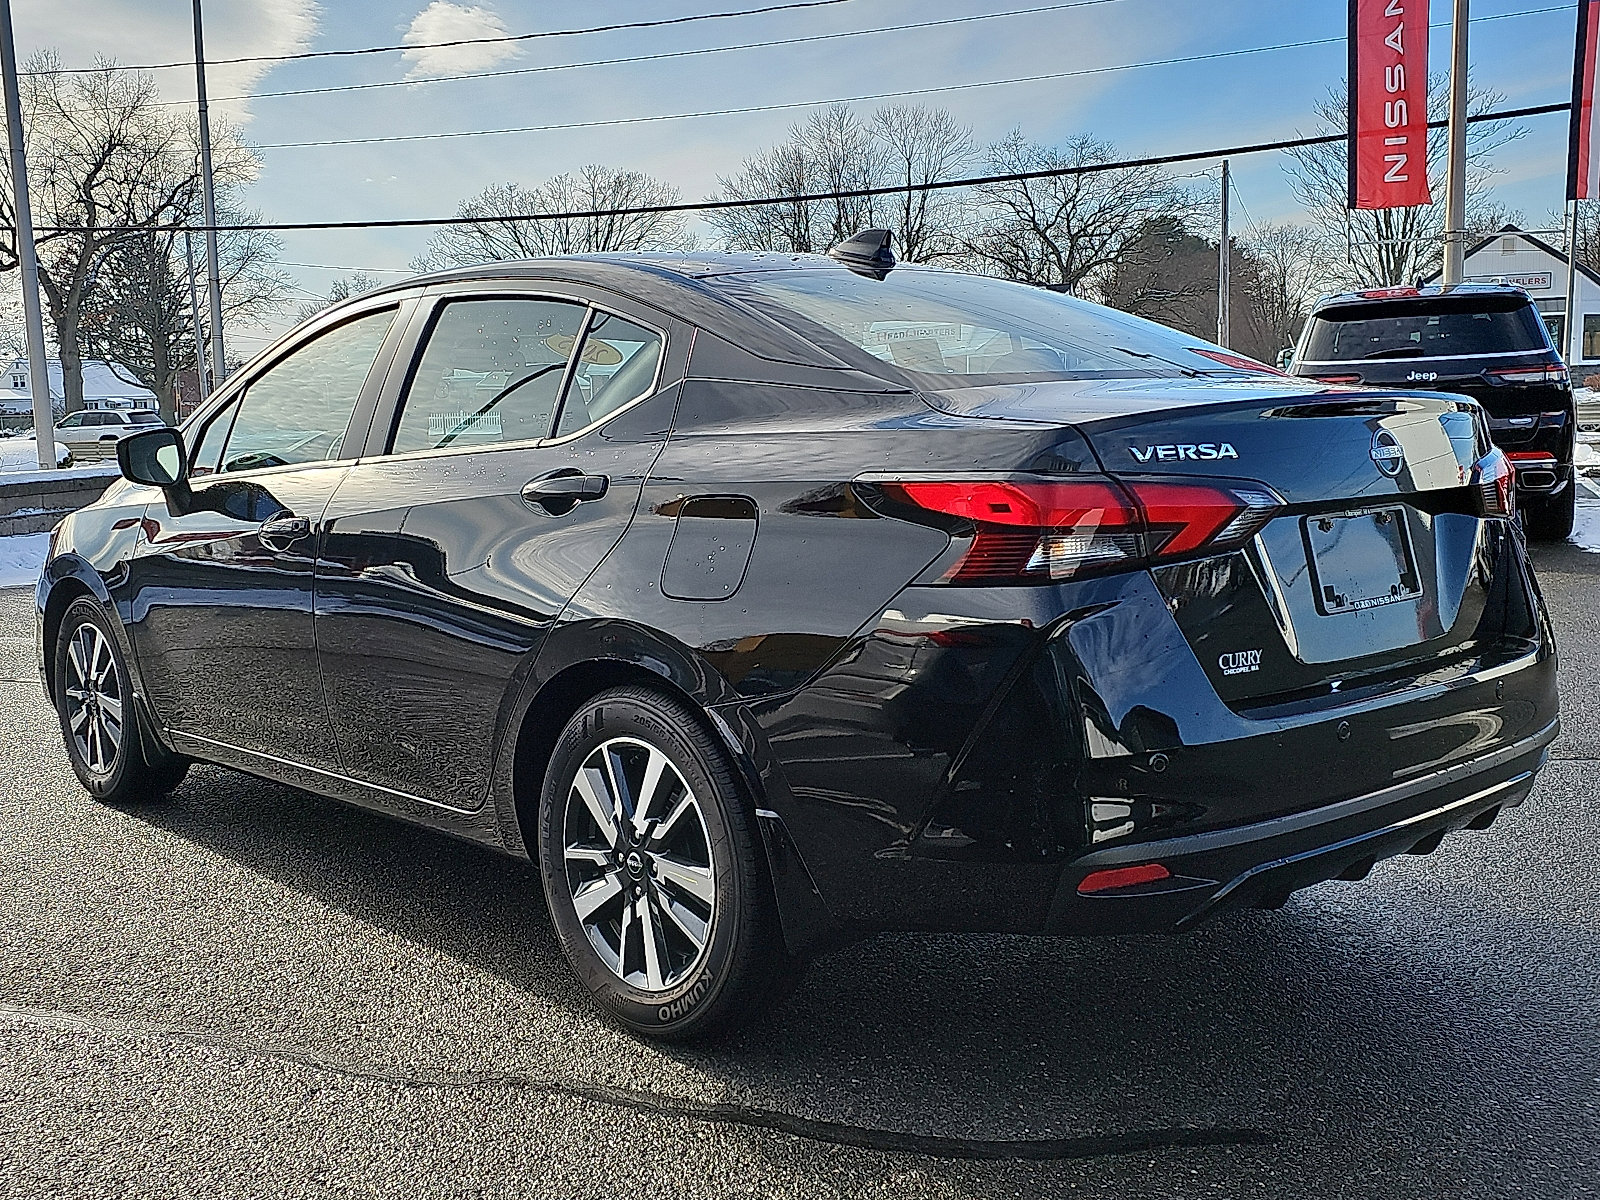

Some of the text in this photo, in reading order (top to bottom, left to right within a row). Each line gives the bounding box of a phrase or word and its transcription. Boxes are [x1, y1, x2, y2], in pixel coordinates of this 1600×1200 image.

[1384, 0, 1408, 183] NISSAN
[1406, 370, 1438, 382] Jeep
[1127, 442, 1240, 463] VERSA
[1218, 648, 1263, 670] CURRY
[658, 966, 714, 1021] KUMHO
